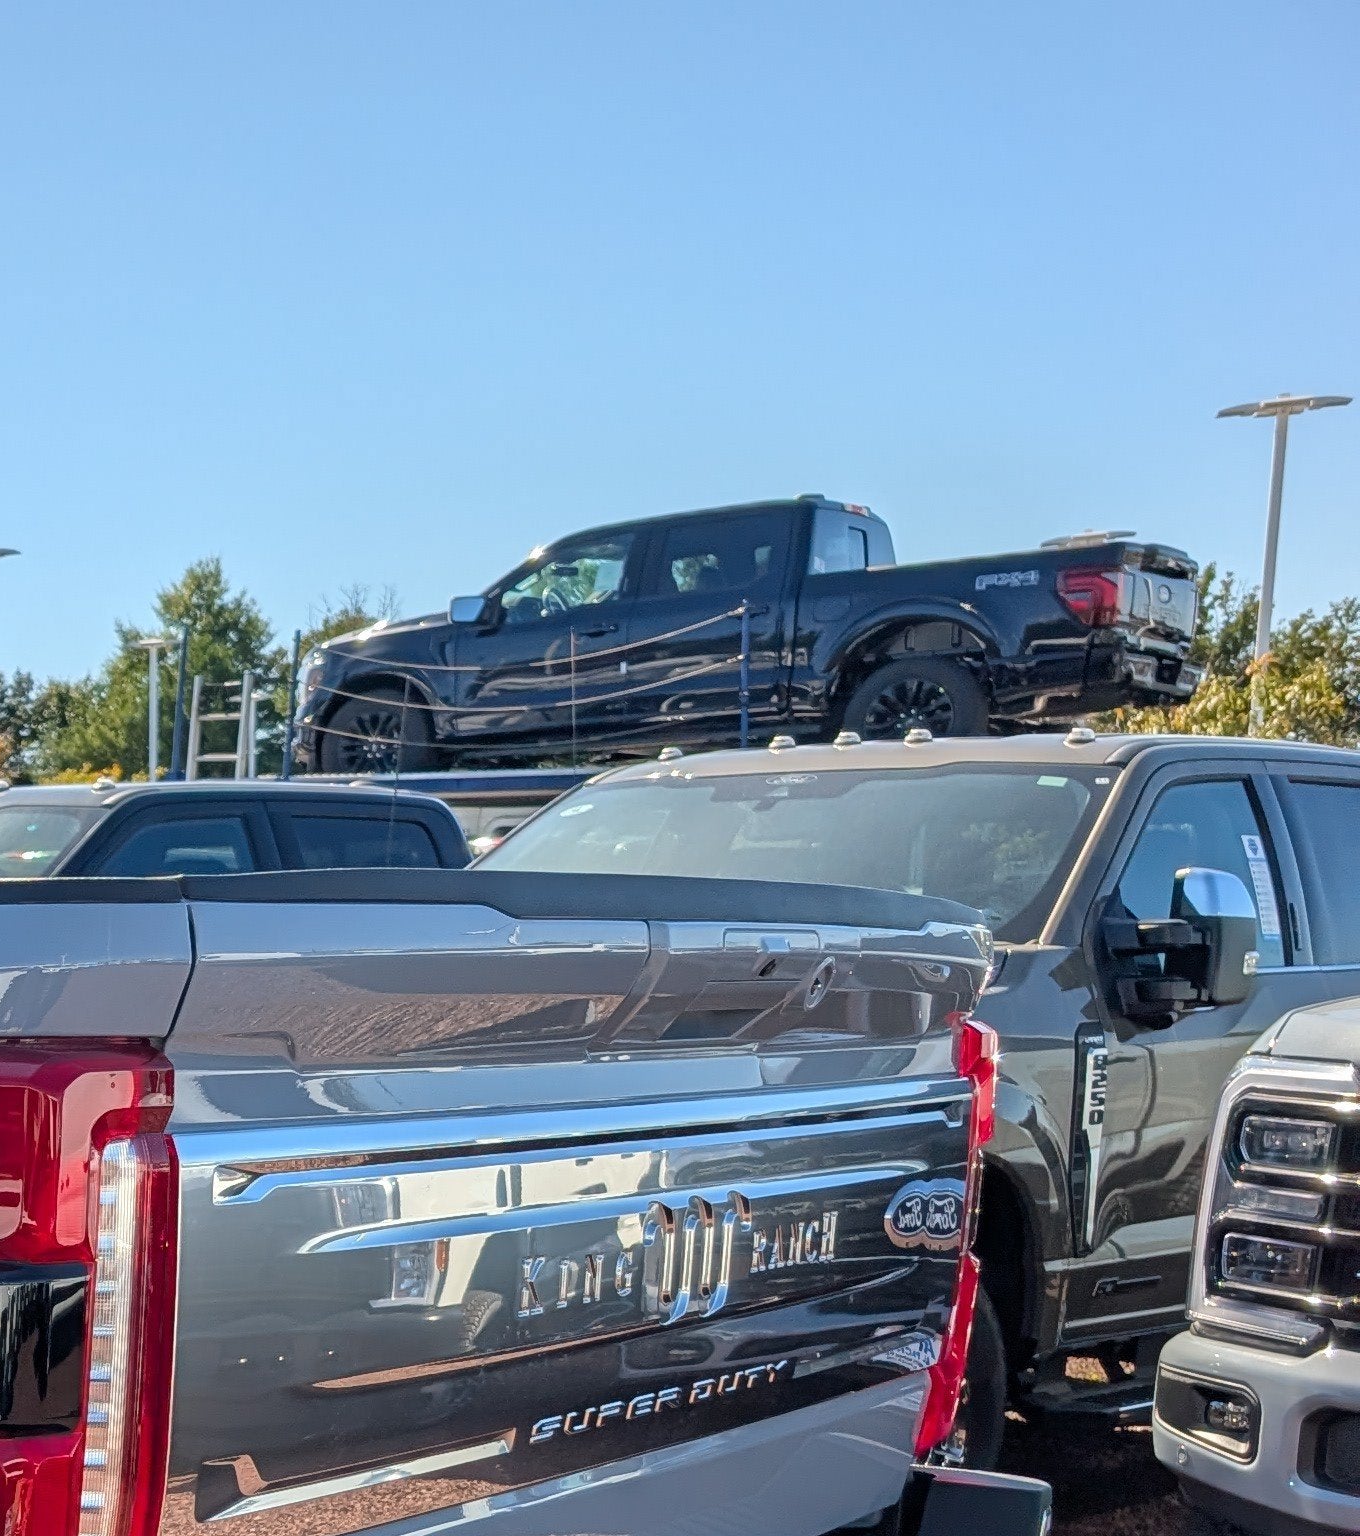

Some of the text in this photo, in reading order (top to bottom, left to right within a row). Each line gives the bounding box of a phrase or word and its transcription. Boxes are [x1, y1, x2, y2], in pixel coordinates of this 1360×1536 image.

[517, 1211, 838, 1318] KING RANCH
[529, 1360, 788, 1446] SUPER DUTY
